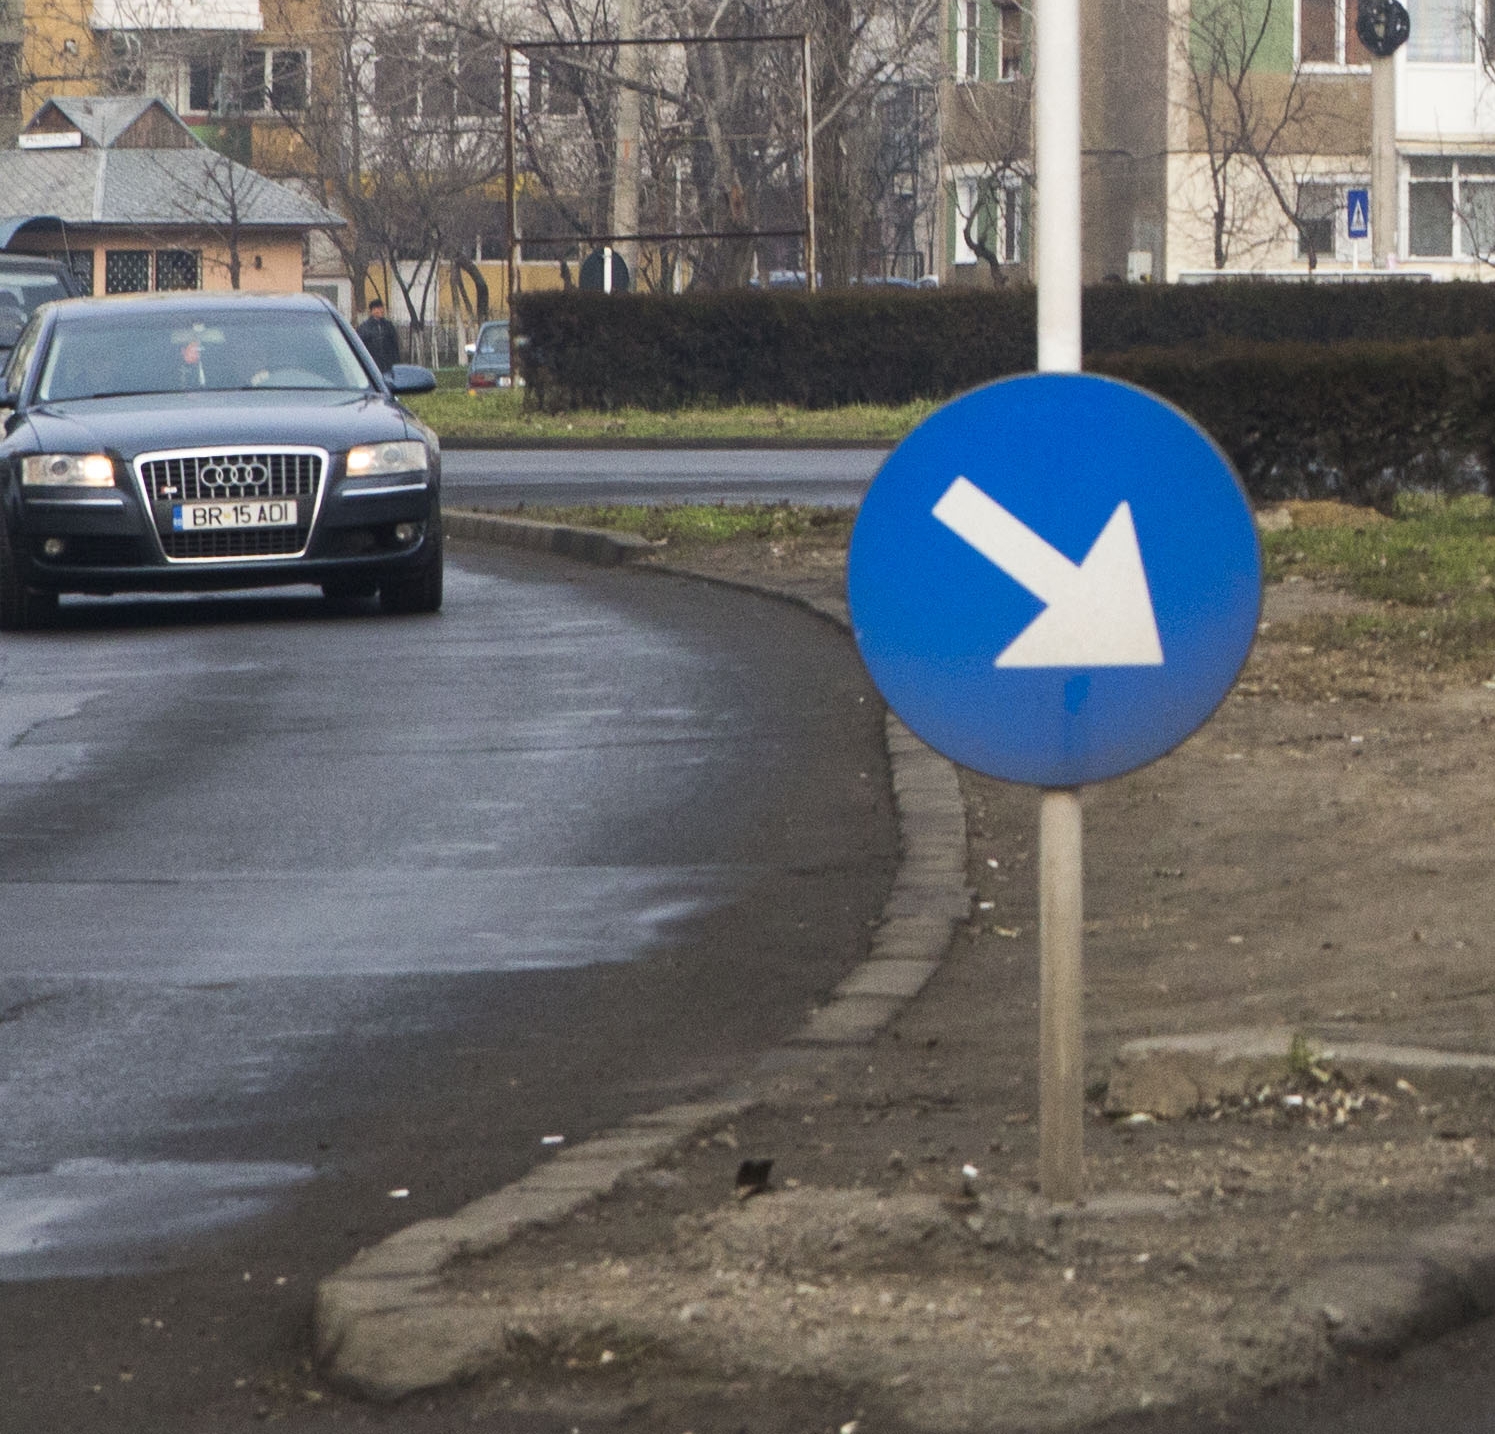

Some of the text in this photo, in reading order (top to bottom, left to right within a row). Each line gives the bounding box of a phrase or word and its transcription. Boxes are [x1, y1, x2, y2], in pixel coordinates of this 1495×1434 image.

[192, 507, 222, 527] BR
[232, 505, 251, 525] 15
[257, 502, 289, 524] ADI
